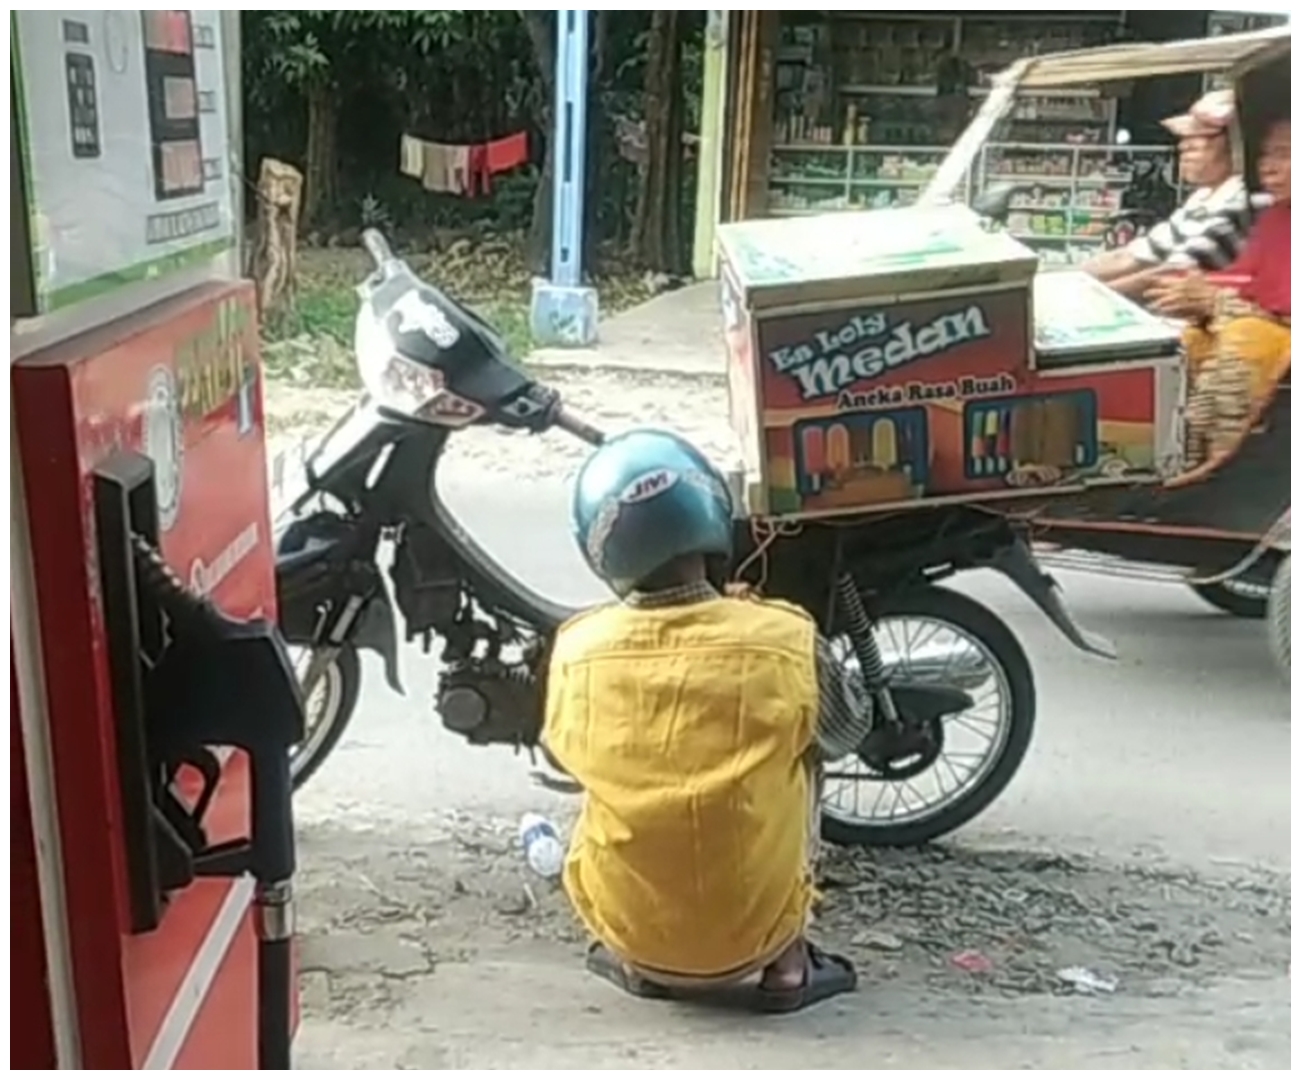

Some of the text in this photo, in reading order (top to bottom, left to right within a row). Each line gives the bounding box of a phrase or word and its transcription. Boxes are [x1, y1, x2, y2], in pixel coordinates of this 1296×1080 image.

[815, 312, 886, 352] Loly
[792, 306, 990, 398] Medan
[837, 375, 1013, 410] Aneka Rasa Buah
[628, 471, 669, 499] JM
